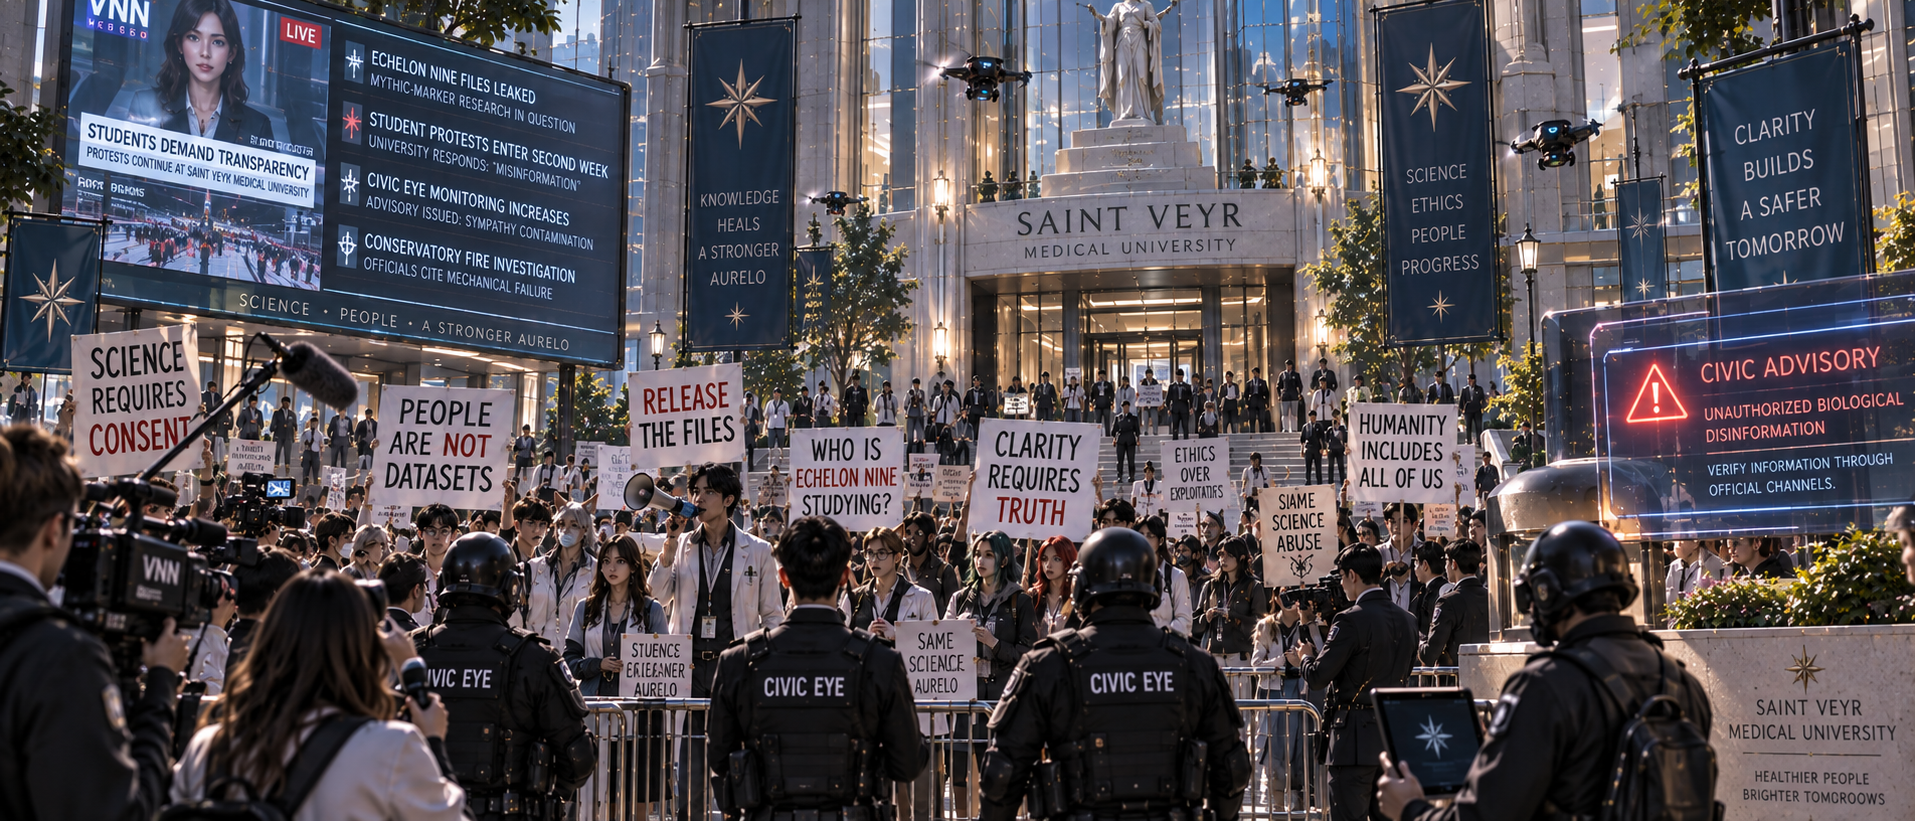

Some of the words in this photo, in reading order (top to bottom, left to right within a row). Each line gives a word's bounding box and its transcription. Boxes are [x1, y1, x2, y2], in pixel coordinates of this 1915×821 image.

[90, 0, 150, 28] VNN
[286, 22, 316, 44] LIVE
[372, 50, 426, 78] ECHELON
[430, 65, 457, 85] NINE
[460, 72, 490, 94] FILES
[494, 81, 536, 105] LEAKED
[370, 73, 455, 105] MYTHIC-MARKER
[459, 94, 511, 119] RESEARCH
[514, 108, 524, 122] IN
[527, 111, 576, 134] QUESTION
[1734, 108, 1816, 147] CLARITY
[87, 121, 157, 151] STUDENTS
[160, 137, 215, 162] DEMAND
[218, 148, 310, 181] TRANSPARENCY
[368, 134, 430, 159] UNIVERSITY
[432, 148, 489, 172] RESPONDS:
[369, 111, 426, 137] STUDENT
[430, 124, 489, 152] PROTESTS
[493, 140, 528, 161] ENTER
[532, 149, 576, 172] SECOND
[579, 159, 609, 179] WEEK
[86, 146, 130, 165] PROTESTS
[131, 155, 173, 174] CONTINUE
[175, 163, 185, 175] AT
[187, 166, 210, 180] SAINT
[233, 174, 266, 191] MEDICAL
[267, 180, 309, 198] UNIVERSITY
[1406, 162, 1467, 185] SCIENCE
[1743, 149, 1814, 182] BUILDS
[368, 172, 400, 193] CIVIC
[404, 179, 426, 198] EYE
[430, 184, 505, 213] MONITORING
[509, 201, 570, 227] INCREASES
[699, 188, 780, 209] KNOWLEDGE
[1411, 193, 1464, 214] ETHICS
[1739, 200, 1753, 220] A
[1759, 187, 1822, 217] SAFER
[366, 195, 419, 217] ADVISORY
[422, 206, 462, 225] ISSUED:
[465, 214, 517, 236] SYMPATHY
[519, 225, 594, 251] CONTAMINATION
[717, 215, 761, 235] HEALS
[1017, 205, 1121, 237] SAINT
[1147, 201, 1243, 231] VEYR
[1411, 224, 1466, 244] PEOPLE
[1725, 222, 1845, 261] TOMORROW
[364, 233, 461, 264] CONSERVATORY
[465, 251, 490, 269] FIRE
[493, 256, 576, 284] INVESTIGATION
[698, 244, 710, 260] A
[712, 241, 779, 259] STRONGER
[1024, 243, 1111, 259] MEDICAL
[1121, 237, 1237, 255] UNIVERSITY
[710, 268, 766, 287] AURELO
[1401, 254, 1479, 277] PROGRESS
[363, 256, 417, 278] OFFICIALS
[420, 265, 443, 282] CITE
[447, 270, 511, 293] MECHANICAL
[514, 281, 553, 300] FAILURE
[239, 293, 309, 316] SCIENCE
[340, 307, 397, 329] PEOPLE
[421, 320, 432, 332] A
[438, 322, 512, 343] STRONGER
[517, 333, 570, 351] AURELO
[90, 340, 184, 380] SCIENCE
[1701, 359, 1756, 383] CIVIC
[1763, 346, 1881, 378] ADVISORY
[92, 380, 187, 414] REQUIRES
[643, 381, 730, 415] RELEASE
[1704, 399, 1812, 421] UNAUTHORIZED
[1817, 391, 1904, 413] BIOLOGICAL
[400, 398, 492, 425] PEOPLE
[89, 416, 192, 456] CONSENT
[639, 421, 676, 449] THE
[683, 415, 735, 447] FILES
[1359, 413, 1447, 436] HUMANITY
[1706, 420, 1825, 443] DISINFORMATION
[389, 431, 432, 455] ARE
[443, 433, 493, 458] NOT
[811, 438, 855, 461] WHO
[864, 437, 882, 460] IS
[995, 430, 1082, 460] CLARITY
[1175, 445, 1215, 463] ETHICS
[1361, 440, 1443, 462] INCLUDES
[1180, 466, 1210, 483] OVER
[1707, 463, 1747, 477] VERIFY
[1751, 458, 1830, 473] INFORMATION
[1834, 452, 1893, 468] THROUGH
[384, 462, 494, 493] DATASETS
[796, 467, 859, 490] ECHELON
[864, 466, 897, 488] NINE
[987, 464, 1081, 494] REQUIRES
[1359, 467, 1389, 488] ALL
[1395, 467, 1416, 489] OF
[1422, 468, 1443, 489] US
[1709, 482, 1762, 497] OFFICIAL
[1766, 477, 1836, 493] CHANNELS.
[802, 493, 892, 516] STUDYING?
[997, 496, 1066, 526] TRUTH
[1278, 492, 1316, 510] SIAME
[1272, 512, 1325, 531] SCIENCE
[1277, 533, 1322, 553] ABUSE
[142, 553, 180, 586] VNN
[918, 632, 954, 650] SAME
[426, 668, 457, 688] IVIC
[462, 669, 493, 689] EYE
[633, 682, 678, 697] AURELO
[764, 677, 807, 698] CIVIC
[814, 676, 845, 698] EYE
[915, 677, 958, 694] AURELO
[1090, 672, 1136, 695] CIVIC
[1143, 671, 1174, 693] EYE
[1756, 699, 1808, 716] SAINT
[1816, 699, 1862, 716] VEYR
[1729, 724, 1796, 740] MEDICAL
[1802, 724, 1896, 741] UNIVERSITY
[1755, 770, 1818, 784] HEALTHIER
[1823, 772, 1869, 785] PEOPLE
[1743, 788, 1800, 802] BRIGHTER
